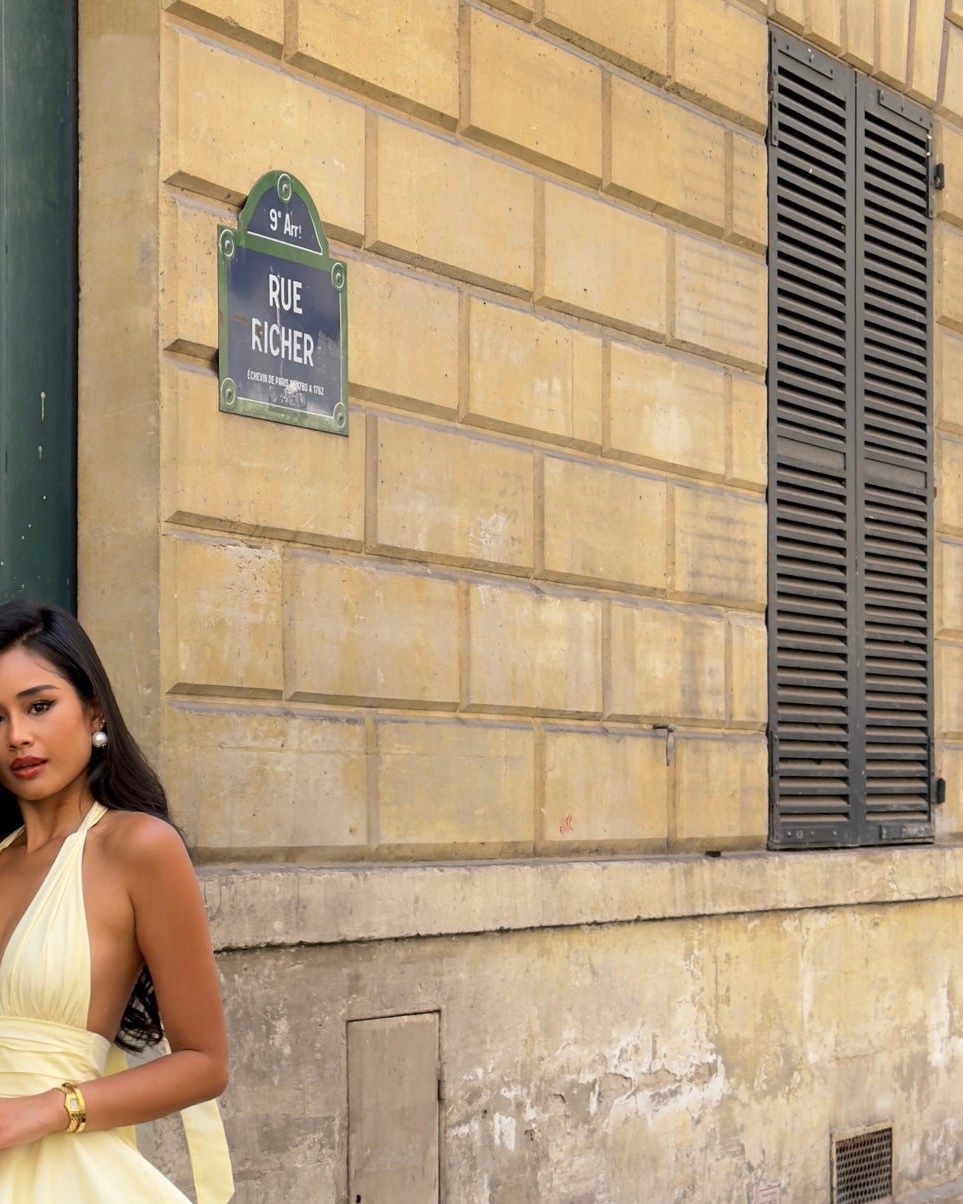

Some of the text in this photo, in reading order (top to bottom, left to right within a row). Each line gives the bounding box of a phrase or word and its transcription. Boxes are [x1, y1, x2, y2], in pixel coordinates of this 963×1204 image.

[268, 274, 303, 314] RUE
[251, 318, 314, 367] RICHER
[268, 374, 275, 385] DE
